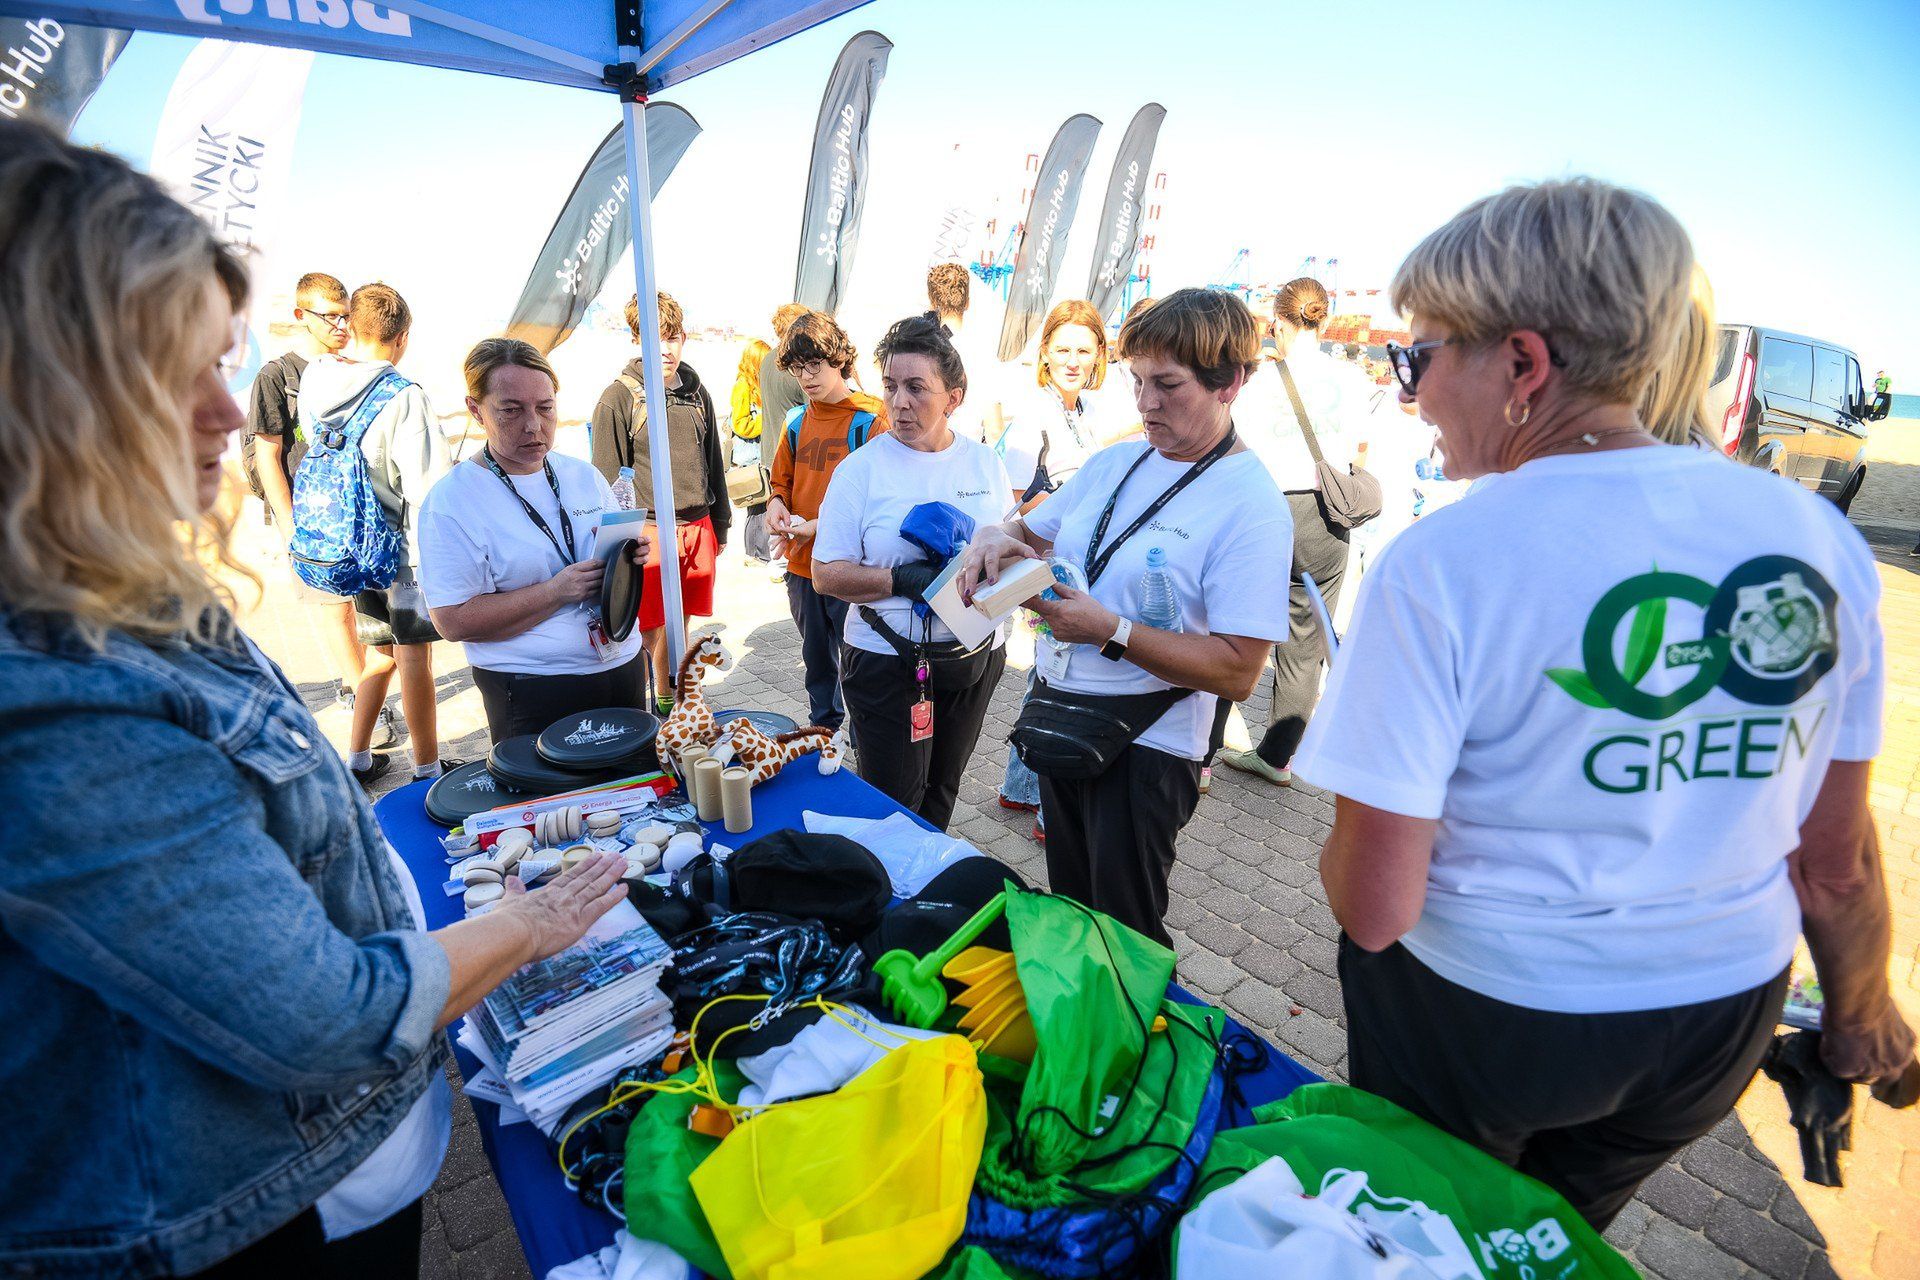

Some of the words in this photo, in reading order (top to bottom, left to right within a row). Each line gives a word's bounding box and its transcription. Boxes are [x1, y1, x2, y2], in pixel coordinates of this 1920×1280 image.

[0, 17, 65, 90] Hub
[188, 123, 232, 212] NNIK
[835, 103, 855, 155] Hub
[222, 134, 266, 232] TYCKI
[576, 198, 620, 263] Baltic
[611, 174, 630, 203] H
[827, 156, 851, 226] Baltic
[1036, 209, 1058, 267] Baltic
[1050, 169, 1069, 210] Hub
[1110, 200, 1132, 257] Baltic
[1122, 160, 1139, 201] Hub
[796, 437, 848, 472] 4F
[1583, 706, 1826, 794] GREEN
